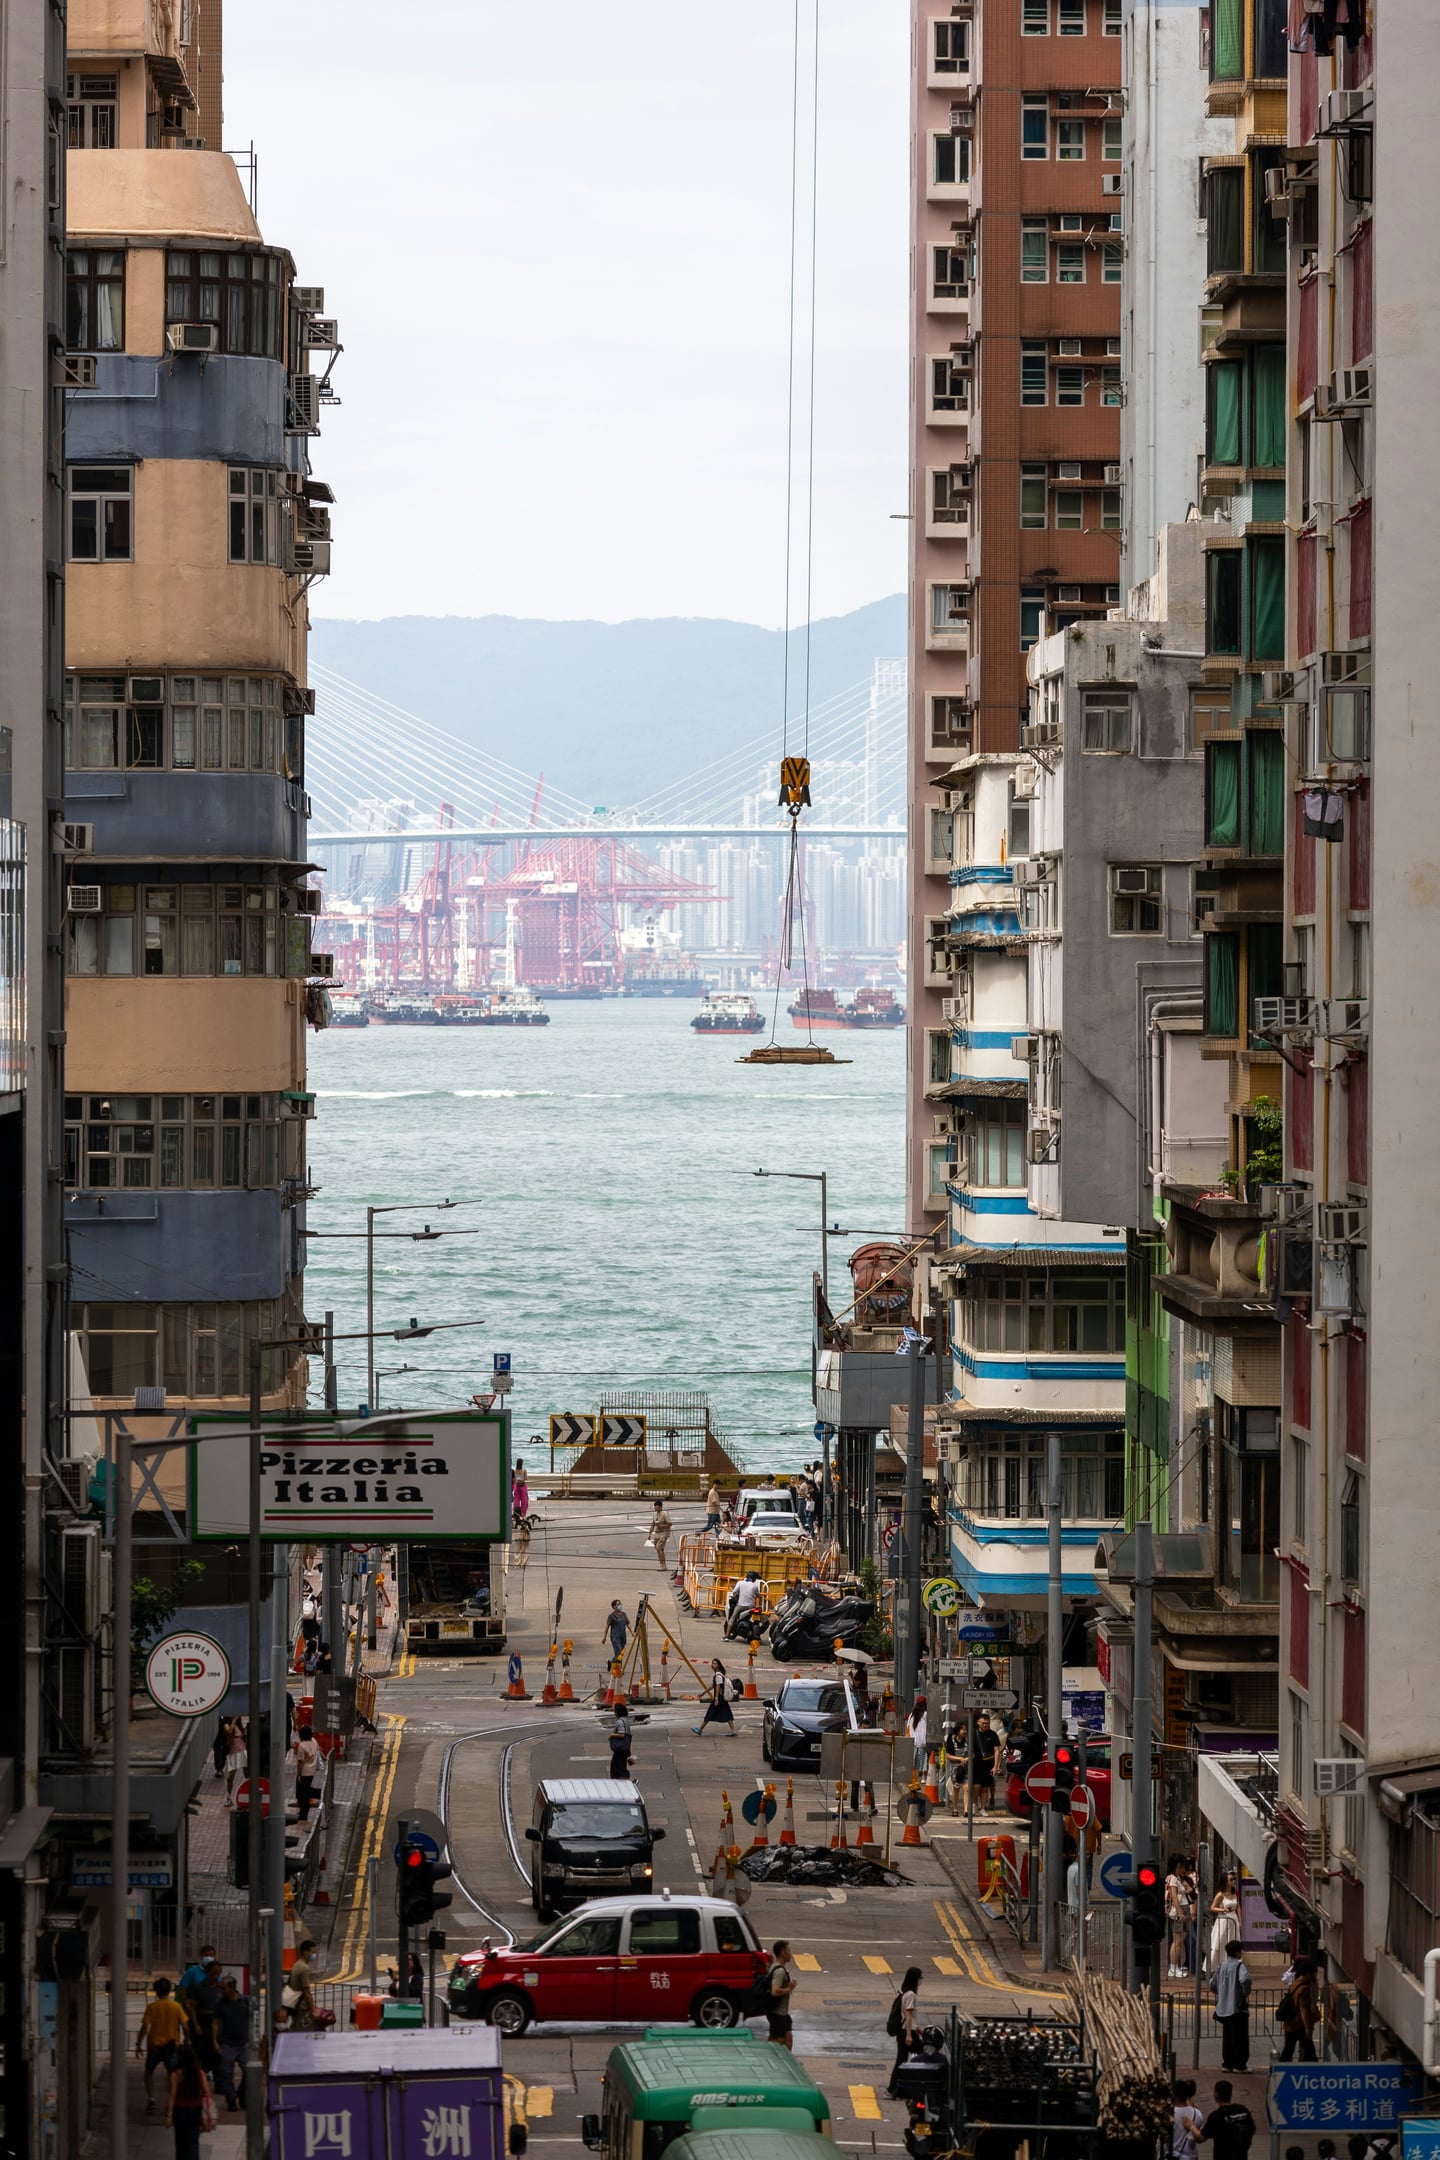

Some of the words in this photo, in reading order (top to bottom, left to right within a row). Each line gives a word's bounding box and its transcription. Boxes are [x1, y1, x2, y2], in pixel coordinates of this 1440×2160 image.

[496, 1354, 508, 1369] P
[259, 1451, 449, 1475] Pizzeria
[274, 1479, 424, 1503] Italia
[164, 1642, 211, 1657] PIZZERIA
[170, 1696, 206, 1707] ITALIA
[650, 1971, 670, 1980] 的士
[650, 1980, 671, 1989] TAXI
[1291, 2074, 1362, 2090] Victoria
[1364, 2075, 1401, 2089] Roa
[690, 2093, 730, 2105] AMS
[1291, 2098, 1395, 2122] 域多利道
